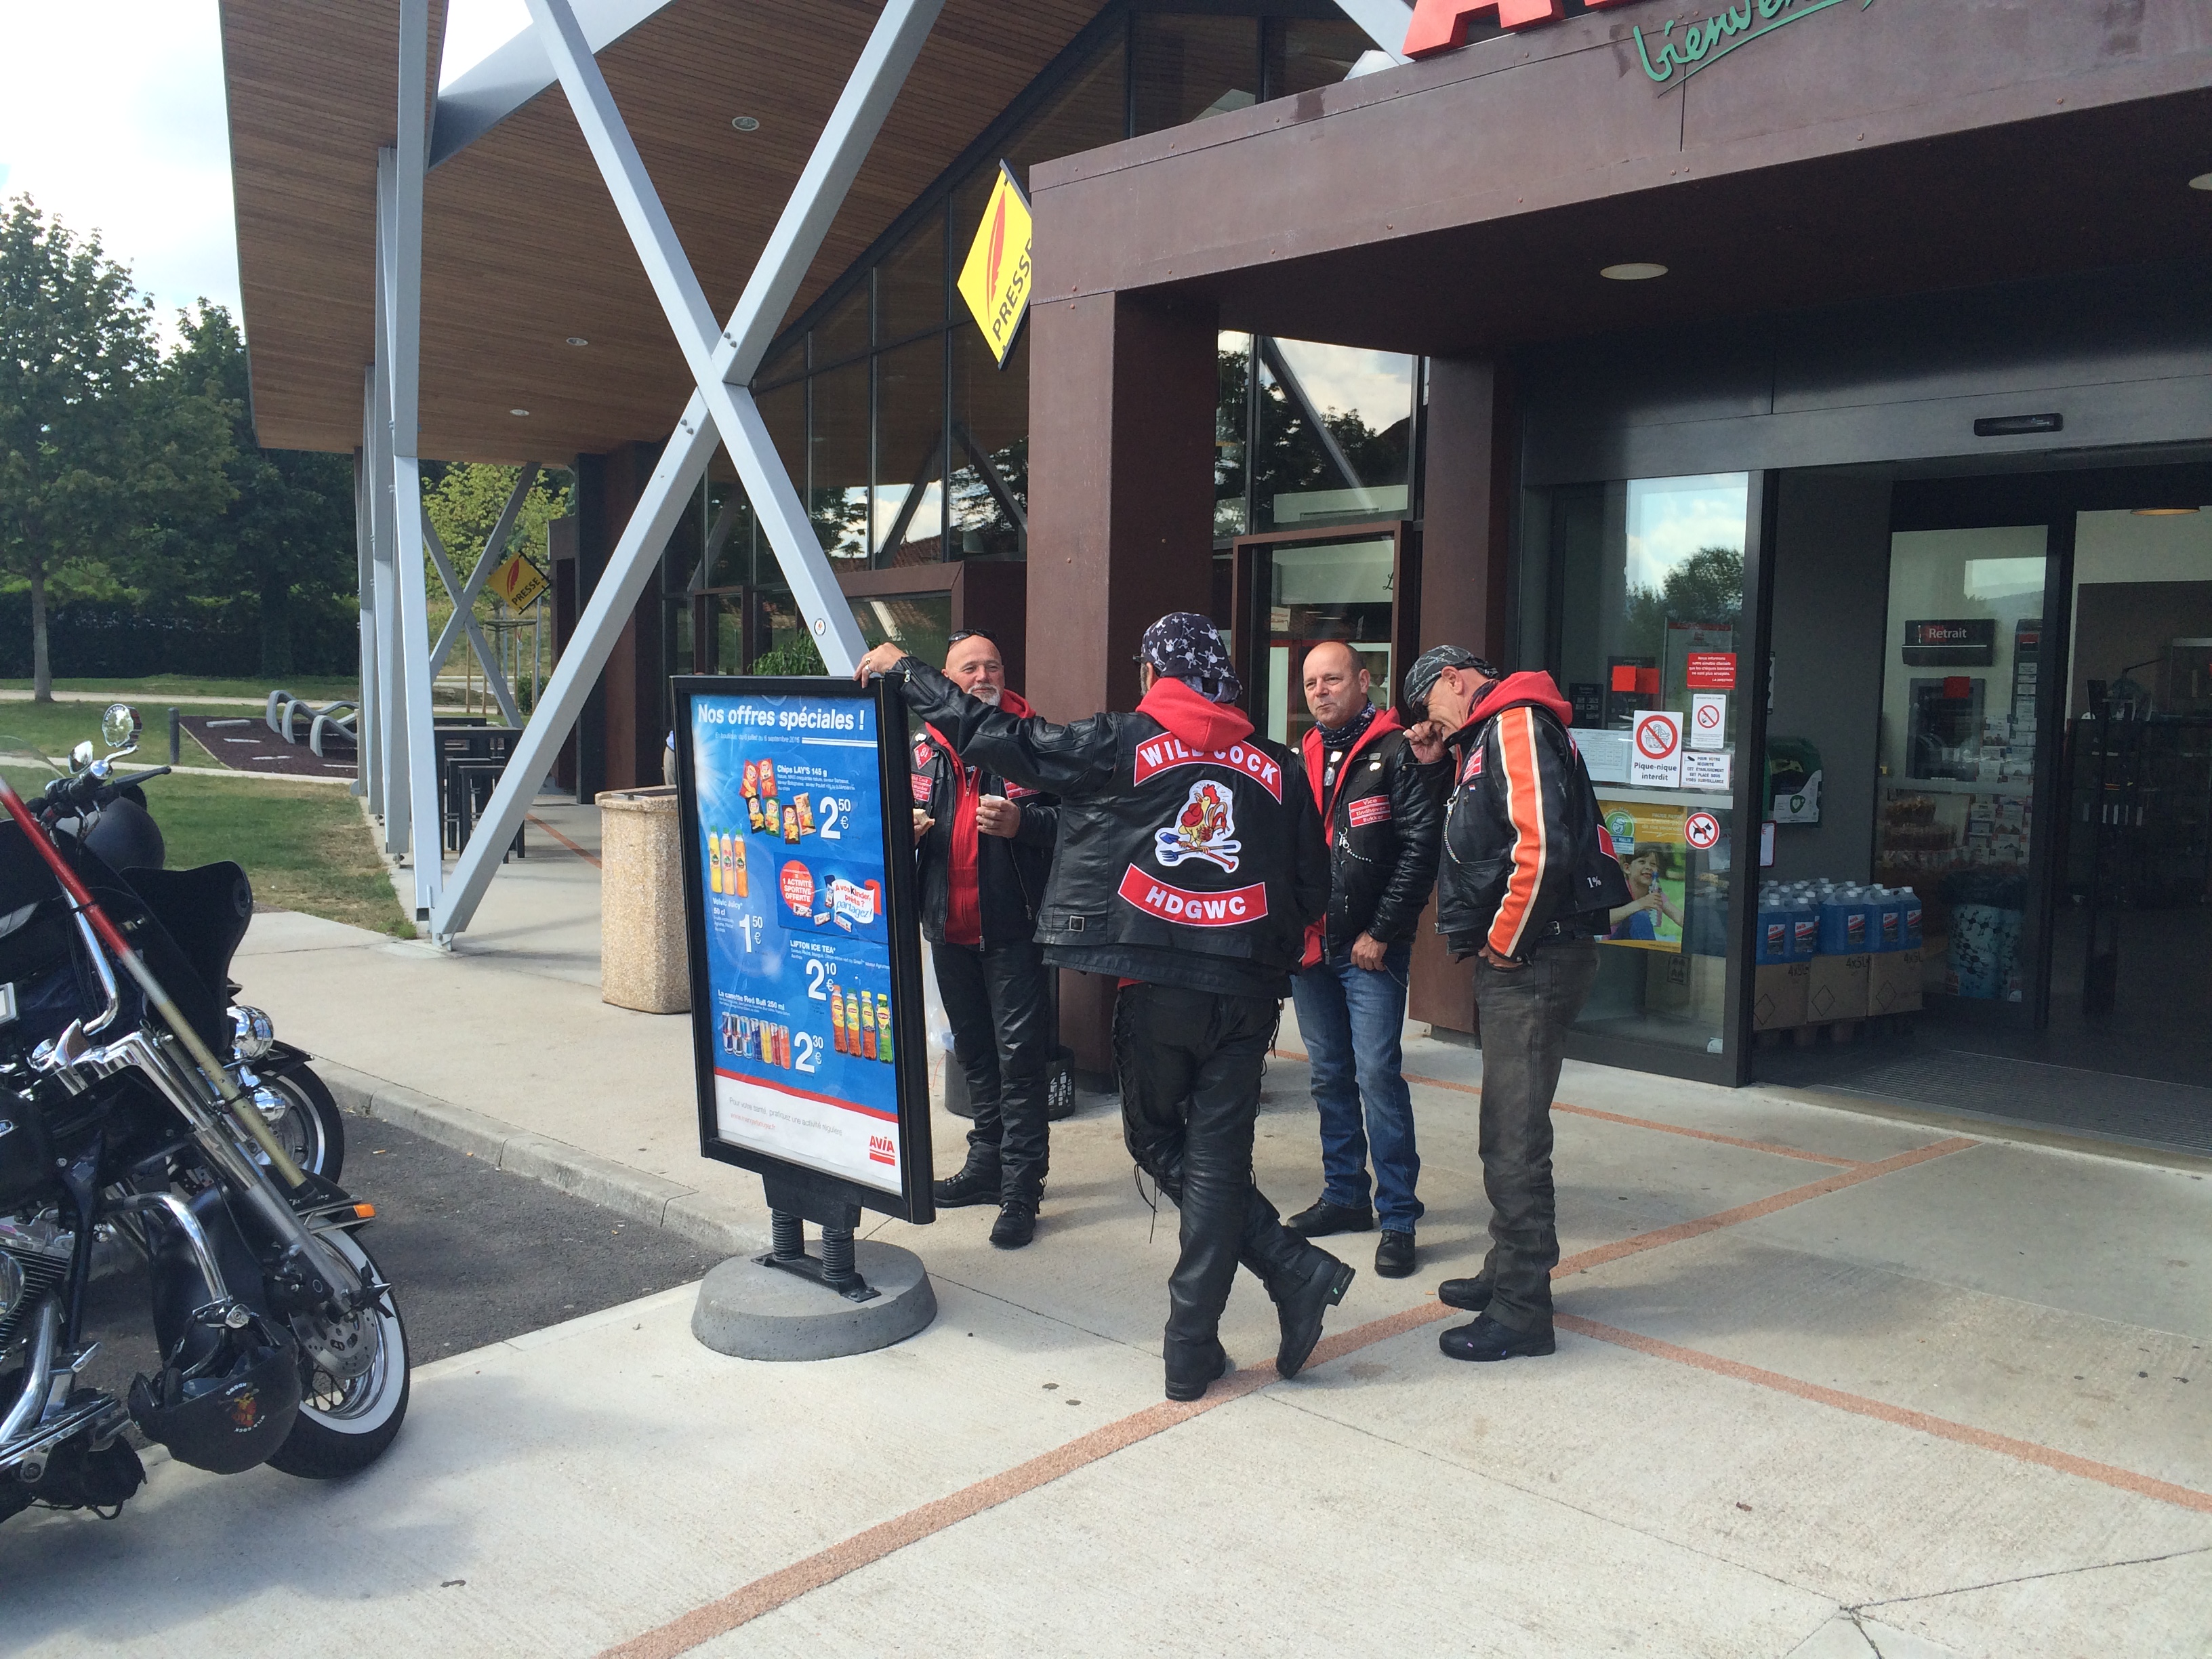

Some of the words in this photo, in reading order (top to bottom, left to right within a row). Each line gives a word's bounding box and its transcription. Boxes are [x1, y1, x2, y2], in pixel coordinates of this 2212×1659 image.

[511, 577, 541, 606] PRESSE
[1929, 628, 1967, 638] Retrait
[698, 704, 724, 724] Nos
[728, 705, 775, 726] offres
[779, 706, 854, 731] spéciales
[777, 764, 793, 774] Chips
[794, 766, 810, 775] LAY'S
[1634, 762, 1677, 773] Pique-nique
[1641, 773, 1668, 781] interdit
[819, 796, 841, 840] 2
[838, 798, 851, 812] 50
[787, 878, 813, 888] ACTIVITÉ
[1586, 876, 1602, 888] 1%
[784, 884, 812, 895] SPORTIVE
[712, 897, 727, 907] Volvic
[785, 893, 811, 903] OFFERTE
[844, 894, 861, 906] prêts
[1145, 885, 1246, 920] HDGWC
[739, 914, 752, 953] 1
[752, 916, 763, 928] 50
[790, 939, 811, 949] LIPTON
[811, 943, 821, 951] ICE
[805, 958, 827, 1001] 2
[825, 962, 837, 976] 10
[718, 989, 724, 998] La
[724, 991, 743, 1002] canette
[743, 996, 755, 1004] Red
[756, 998, 766, 1006] Bull
[766, 1000, 777, 1008] 250
[794, 1031, 815, 1073] 2
[813, 1035, 824, 1049] 30
[729, 1097, 740, 1106] Pour
[741, 1103, 753, 1111] votre
[753, 1105, 768, 1115] santé,
[769, 1109, 791, 1122] pratiquez
[802, 1120, 821, 1129] activité
